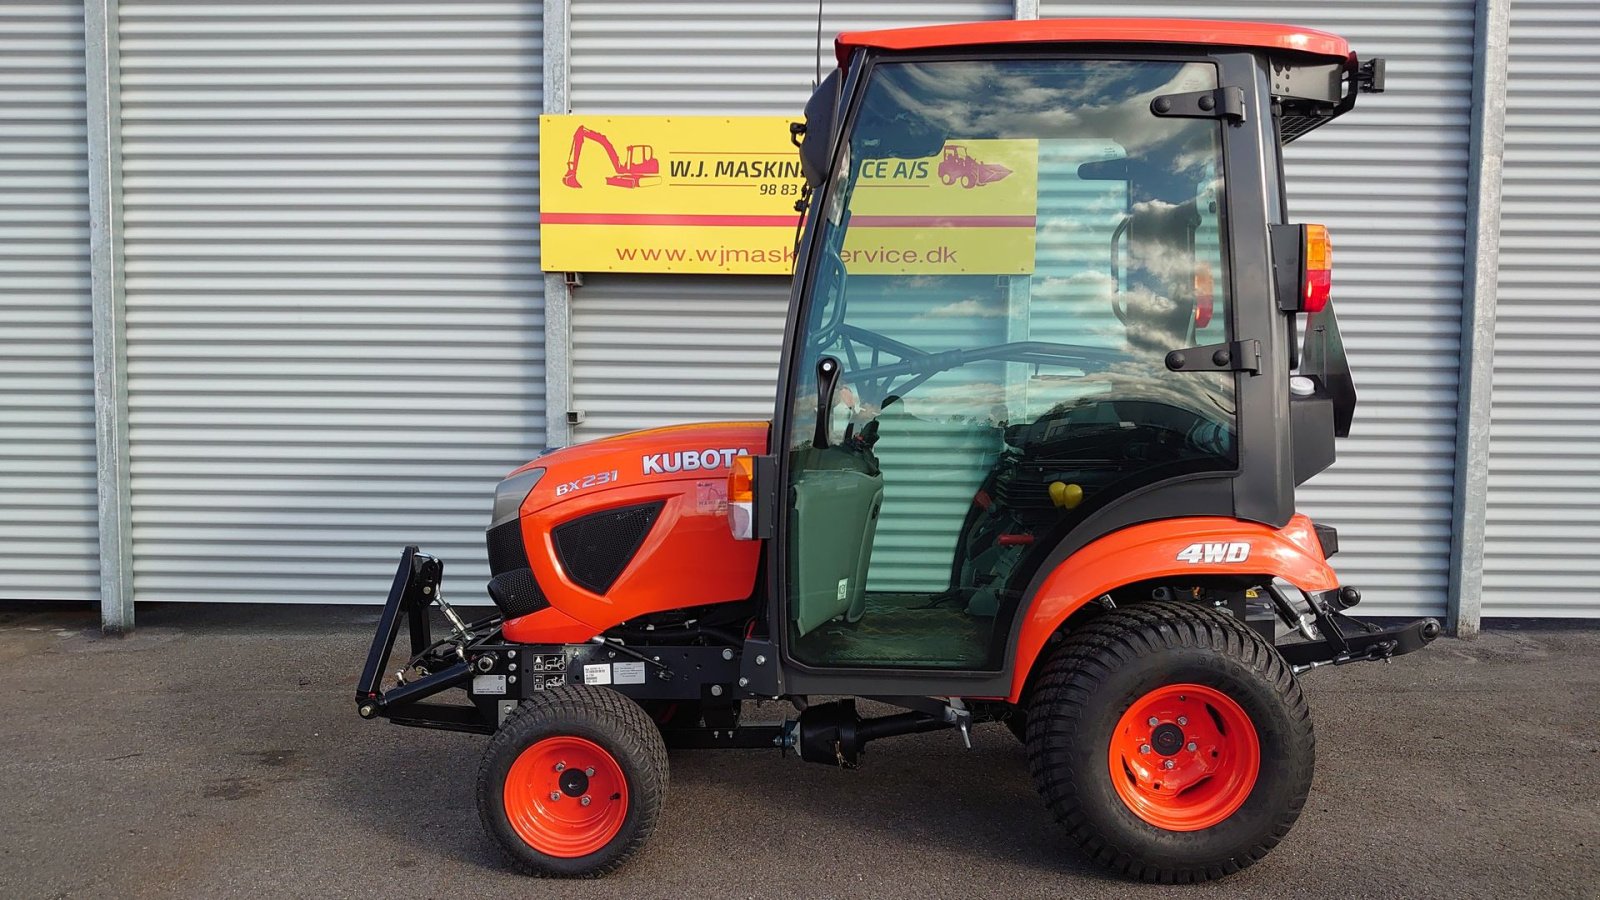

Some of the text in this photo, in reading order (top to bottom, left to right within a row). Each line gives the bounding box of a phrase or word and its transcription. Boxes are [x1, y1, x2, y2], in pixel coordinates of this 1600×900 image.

[670, 160, 709, 178] W.J.
[892, 161, 929, 179] A/S
[759, 183, 798, 196] 98 83
[556, 469, 618, 497] BX231
[1176, 542, 1251, 564] 4WD
